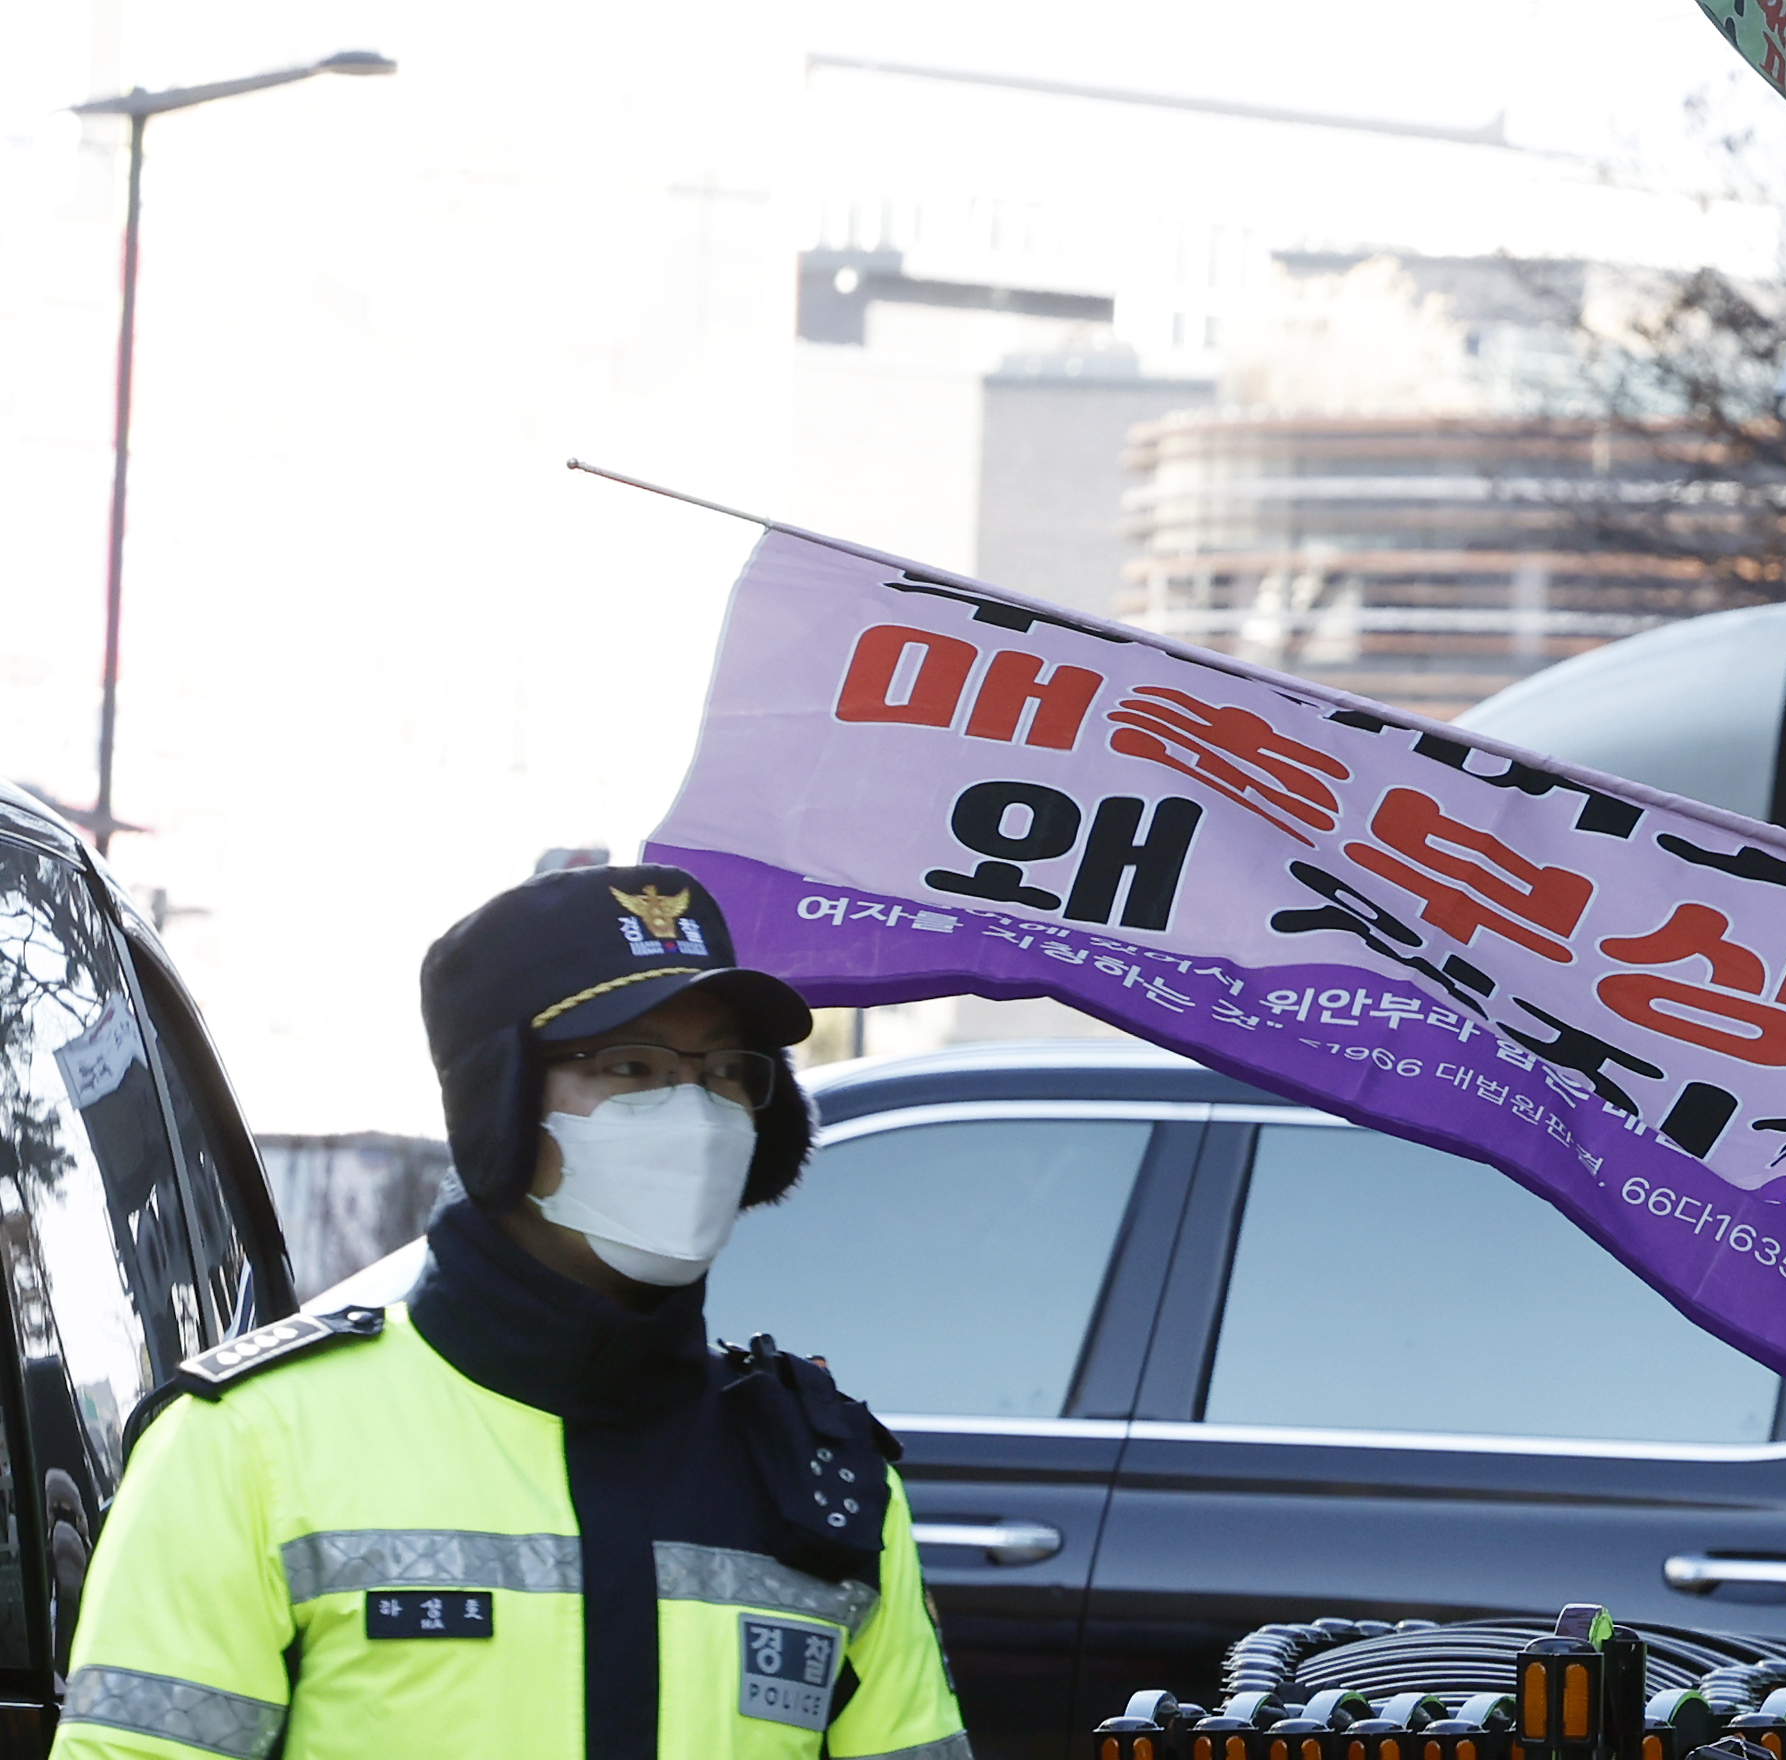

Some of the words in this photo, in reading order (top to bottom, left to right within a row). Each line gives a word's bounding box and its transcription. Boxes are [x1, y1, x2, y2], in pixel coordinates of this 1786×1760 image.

[925, 780, 1204, 931] 왜
[796, 894, 967, 935] 여자를
[981, 925, 1197, 1013] 지칭하는
[1259, 986, 1482, 1044] 위안부라
[750, 1626, 831, 1684] 경찰
[749, 1682, 822, 1716] POLICE
